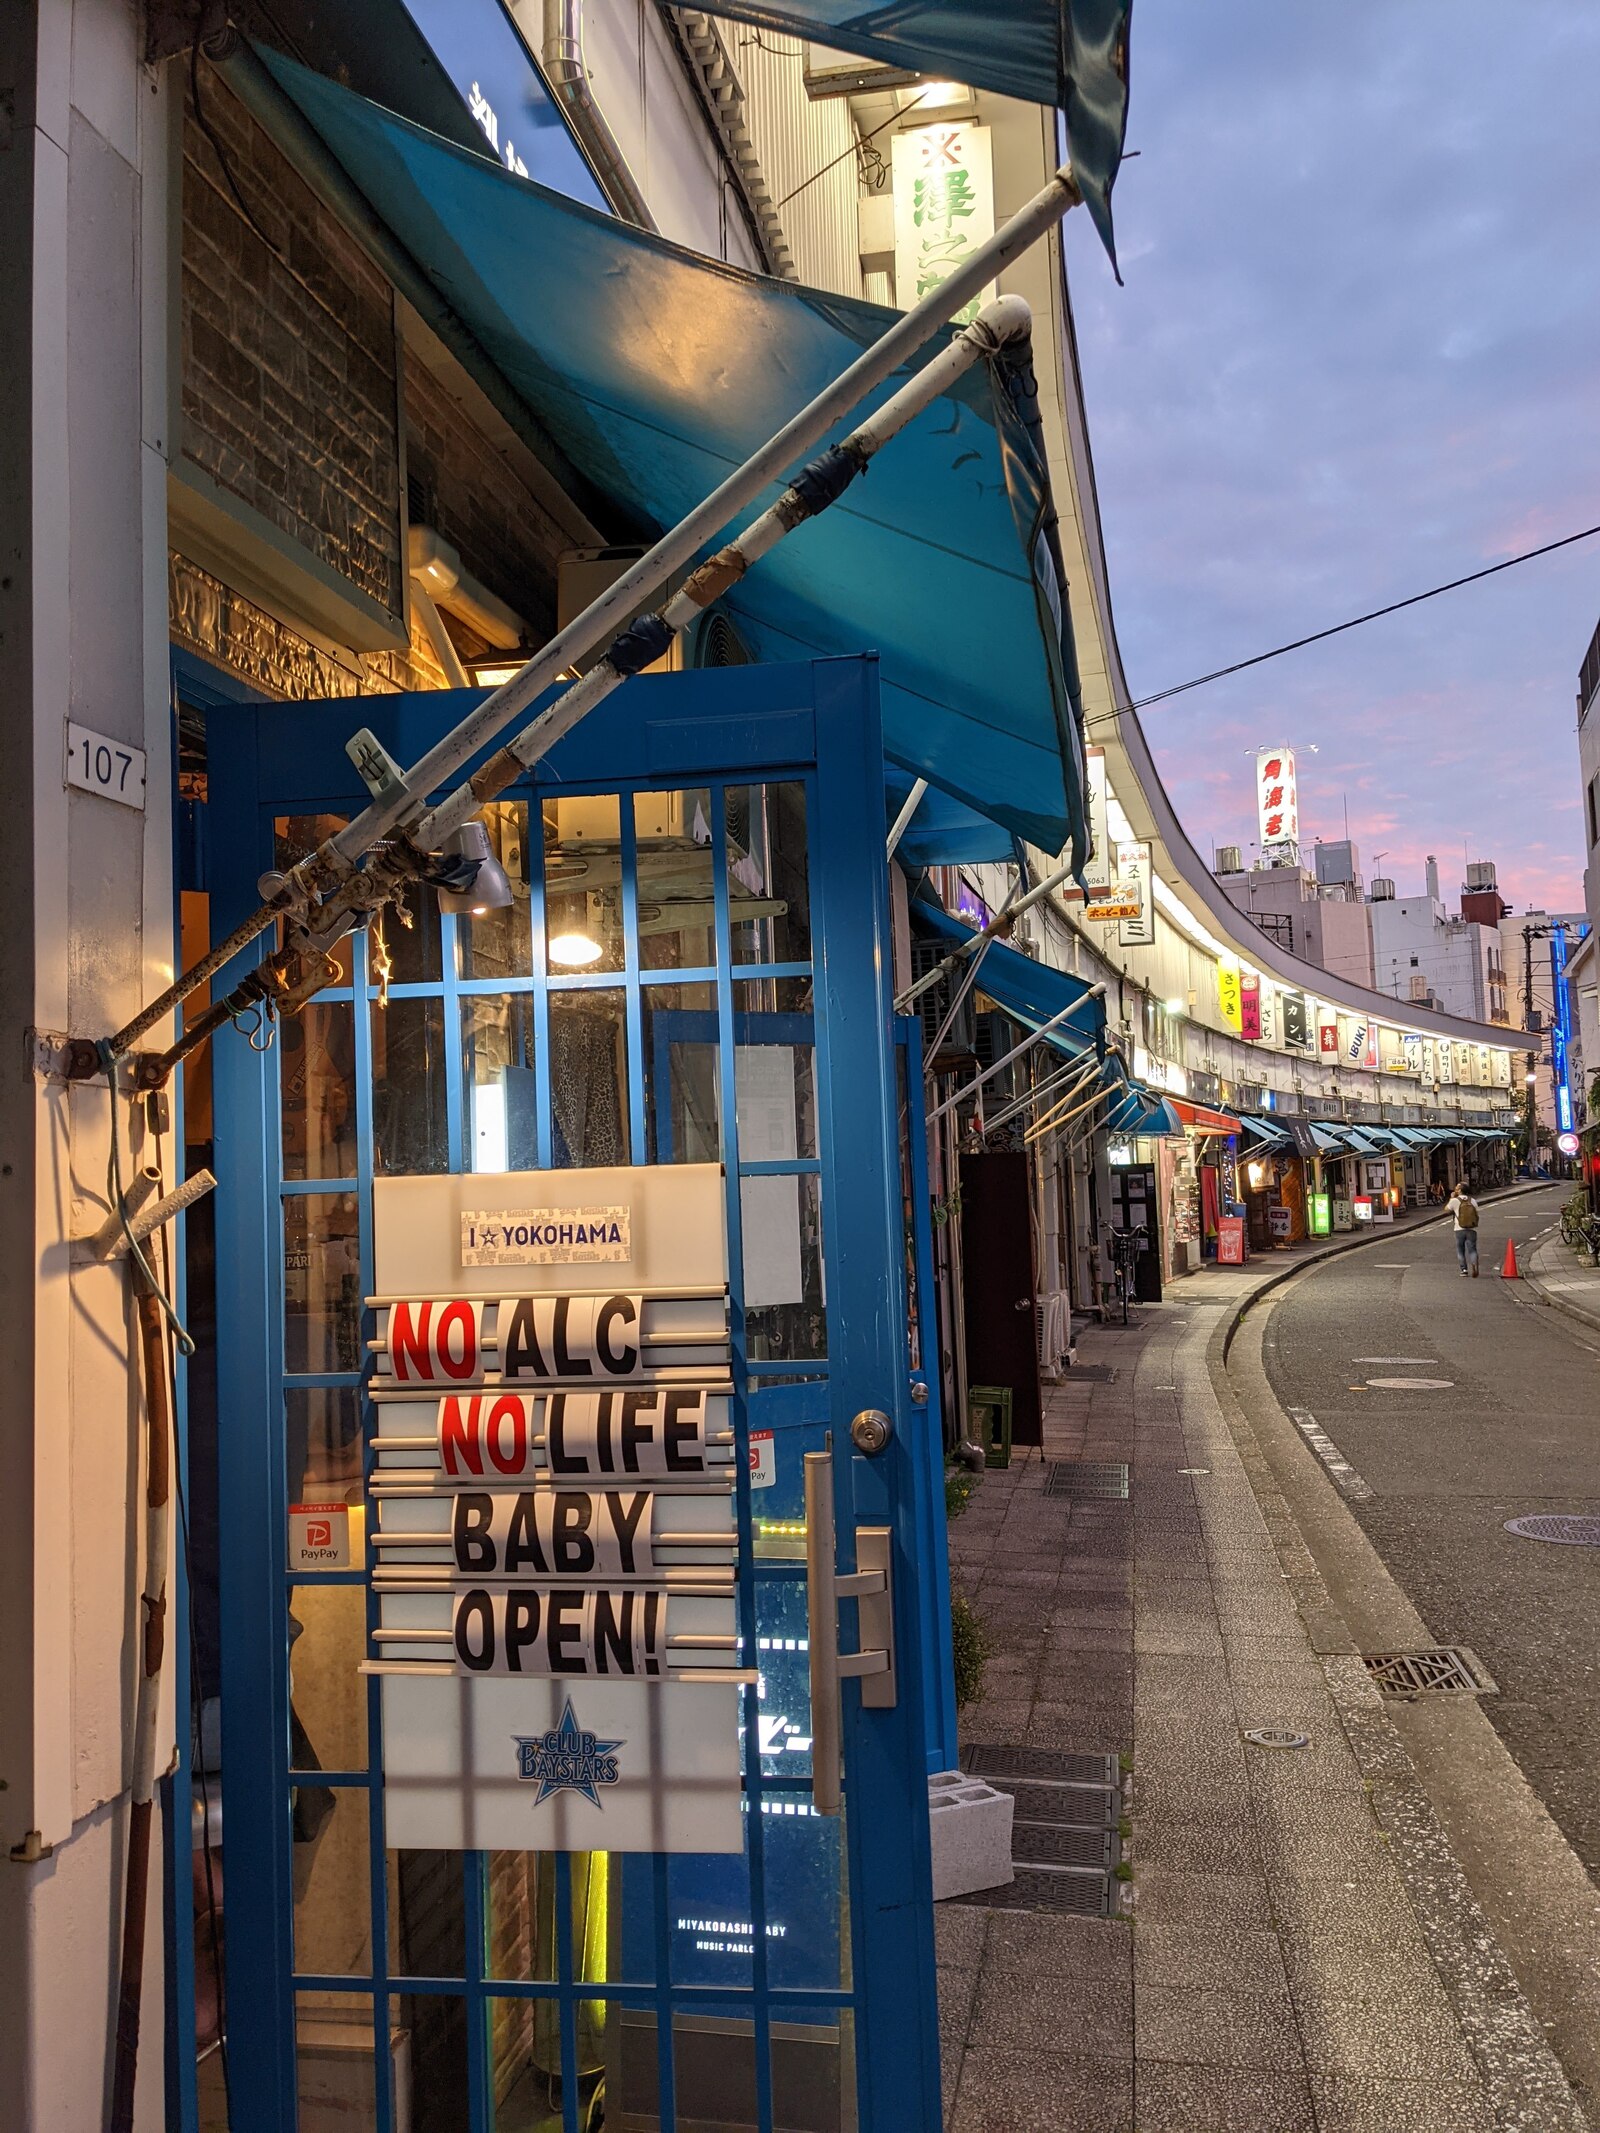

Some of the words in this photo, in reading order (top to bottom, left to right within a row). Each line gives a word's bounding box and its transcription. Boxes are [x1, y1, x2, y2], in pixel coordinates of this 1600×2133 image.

[82, 739, 132, 792] 107
[1223, 973, 1236, 1015] さつき
[1242, 1000, 1258, 1032] 明美
[1349, 1026, 1366, 1058] IBUKI
[470, 1227, 475, 1247] I
[502, 1222, 622, 1246] YOKOHAMA
[284, 1255, 312, 1268] PARI
[391, 1300, 476, 1381] NO
[504, 1296, 638, 1377] ALC
[440, 1395, 527, 1475] NO
[545, 1390, 704, 1473] LIFE
[454, 1491, 652, 1573] BABY
[301, 1549, 338, 1560] PayPay
[455, 1589, 661, 1675] OPEN!
[543, 1731, 596, 1756] CLUB
[519, 1743, 618, 1783] BAYSTARS
[678, 1919, 754, 1934] MIYAKOBASHI
[765, 1925, 786, 1937] ABY
[696, 1941, 724, 1951] MUSIC
